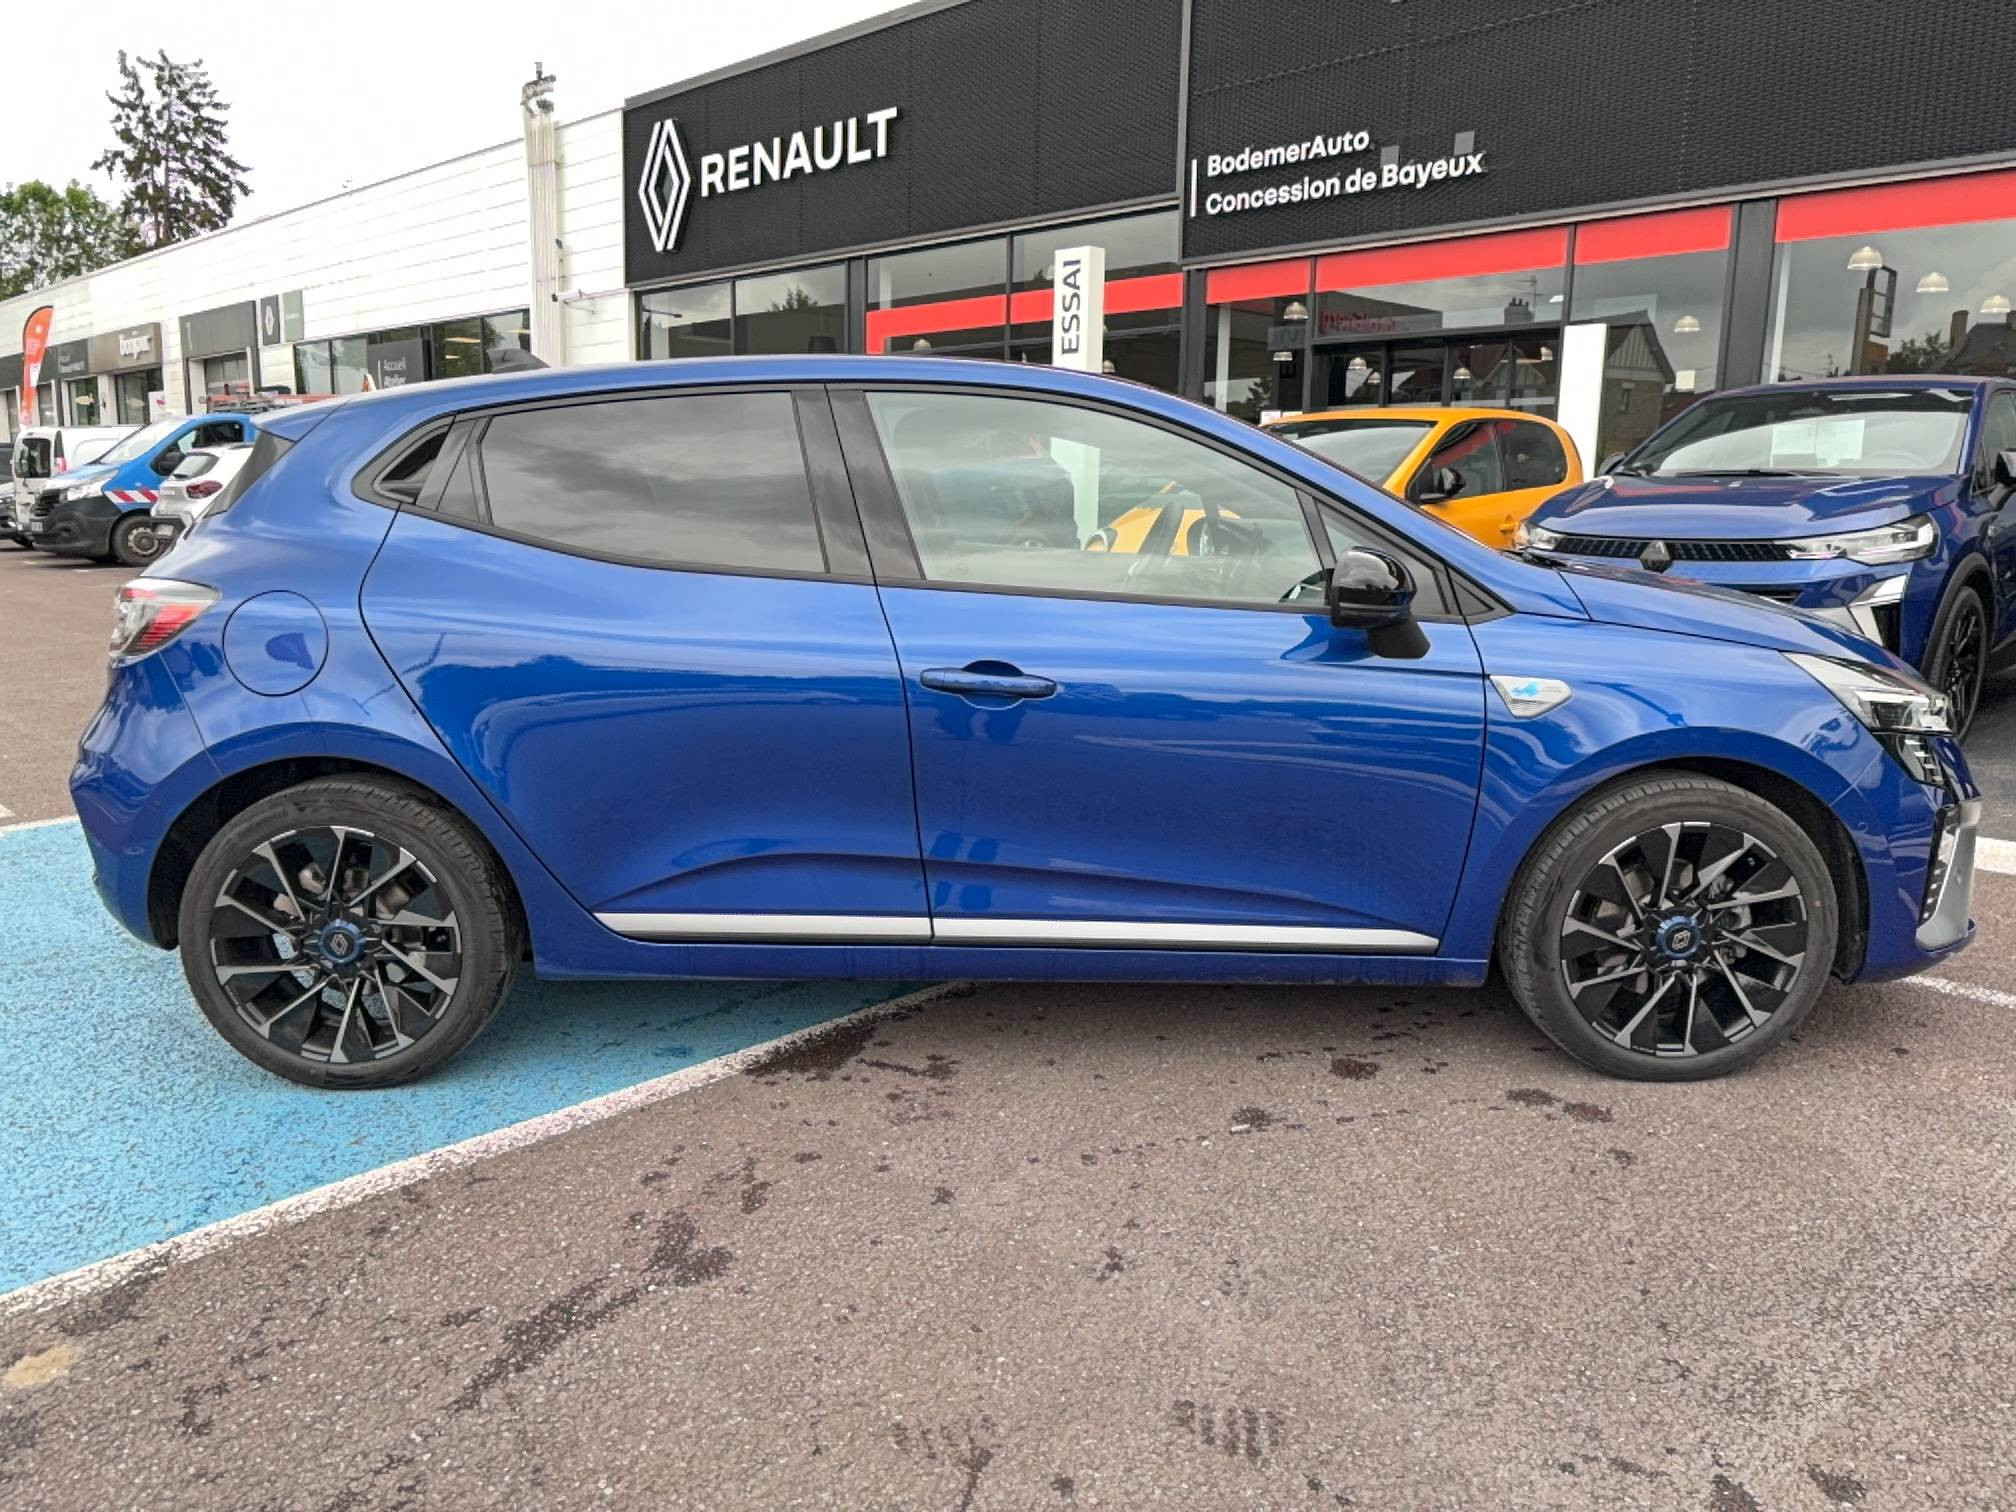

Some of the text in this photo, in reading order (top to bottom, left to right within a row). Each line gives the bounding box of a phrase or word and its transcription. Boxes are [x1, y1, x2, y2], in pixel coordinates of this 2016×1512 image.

[701, 106, 898, 198] RENAULT
[1206, 152, 1484, 215] Concession de Bayeux
[1207, 129, 1370, 177] BodemerAuto
[1061, 258, 1081, 355] ESSAI
